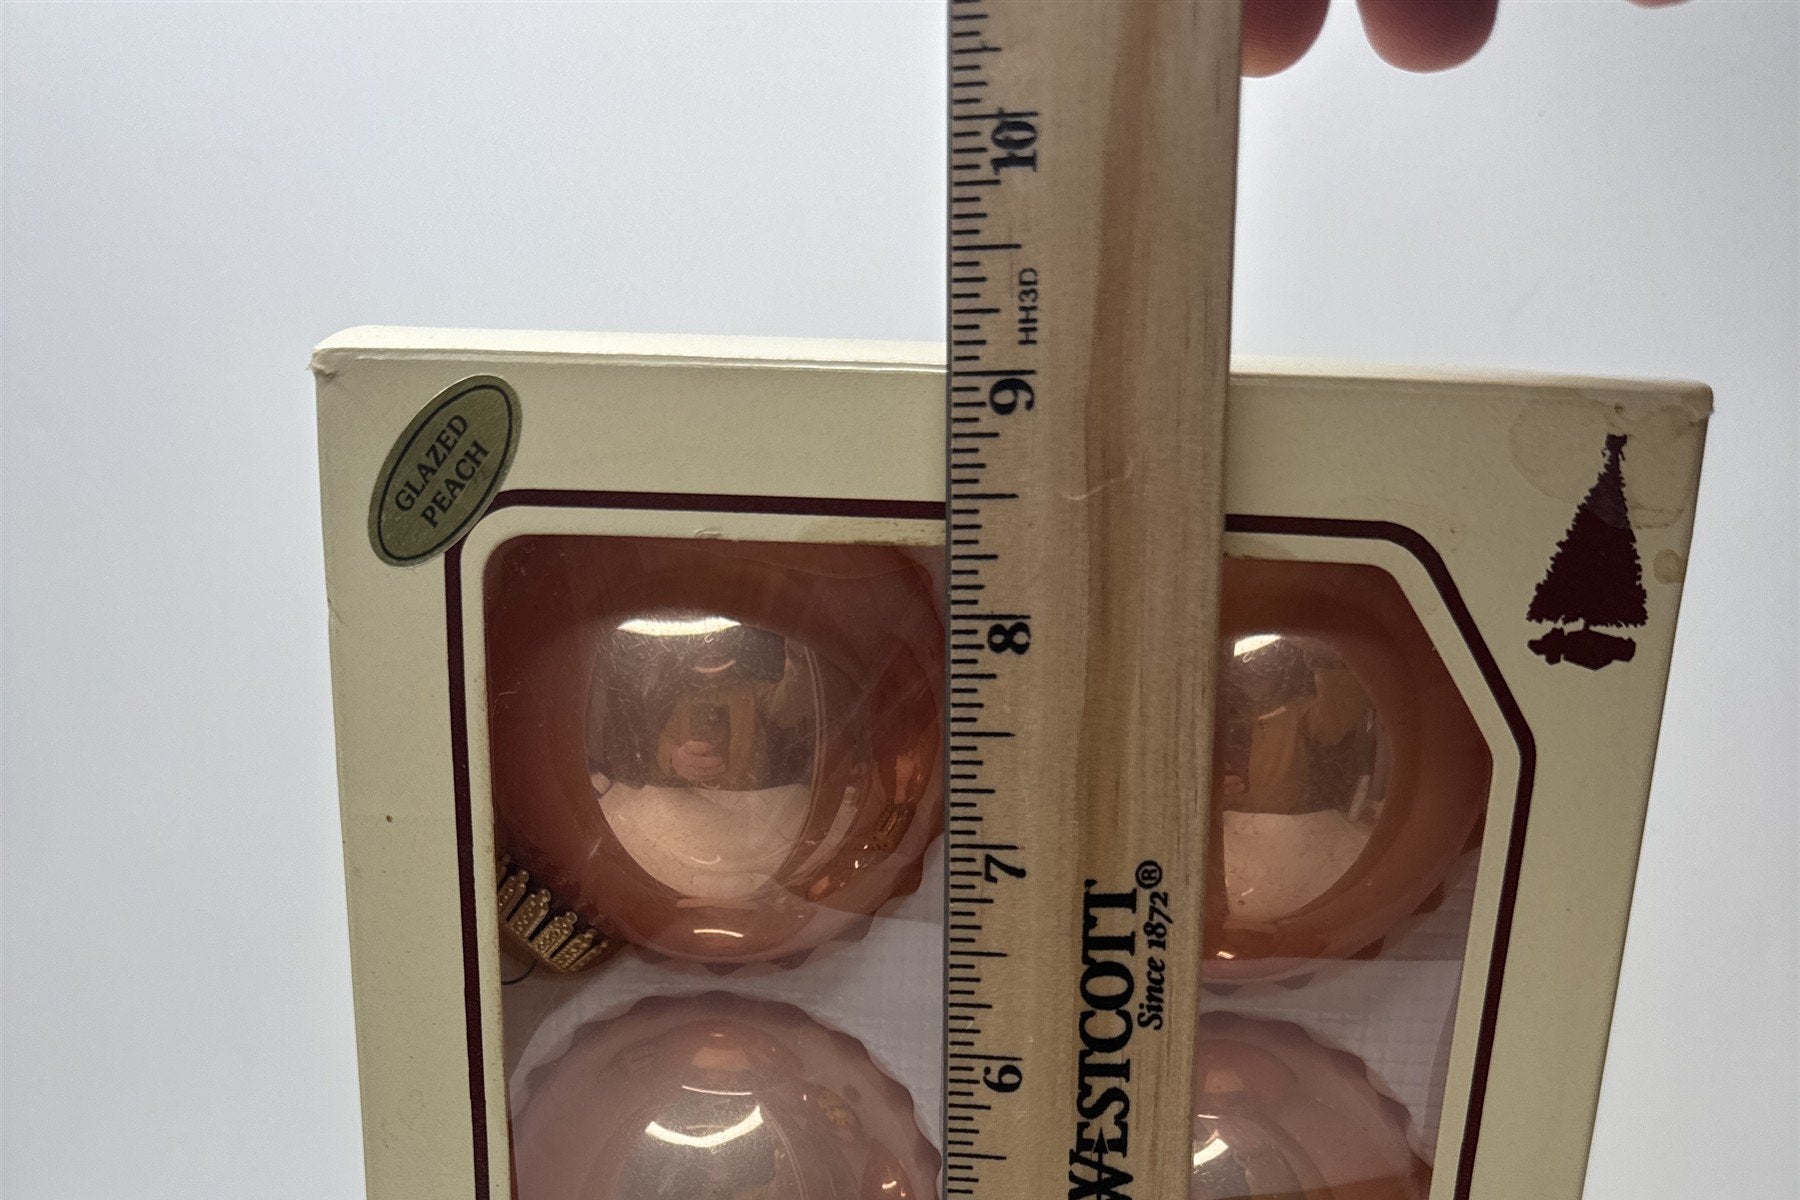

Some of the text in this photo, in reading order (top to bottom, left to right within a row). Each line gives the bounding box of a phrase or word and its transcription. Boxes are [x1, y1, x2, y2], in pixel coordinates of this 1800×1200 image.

[990, 120, 1039, 174] 10
[1018, 267, 1039, 345] HH3D
[989, 377, 1036, 416] 9
[394, 414, 468, 512] GLAZED
[421, 440, 489, 529] PEACH
[987, 621, 1031, 655] 8
[984, 853, 1027, 884] 7
[1137, 956, 1166, 1031] Since
[982, 1064, 1023, 1093] 6
